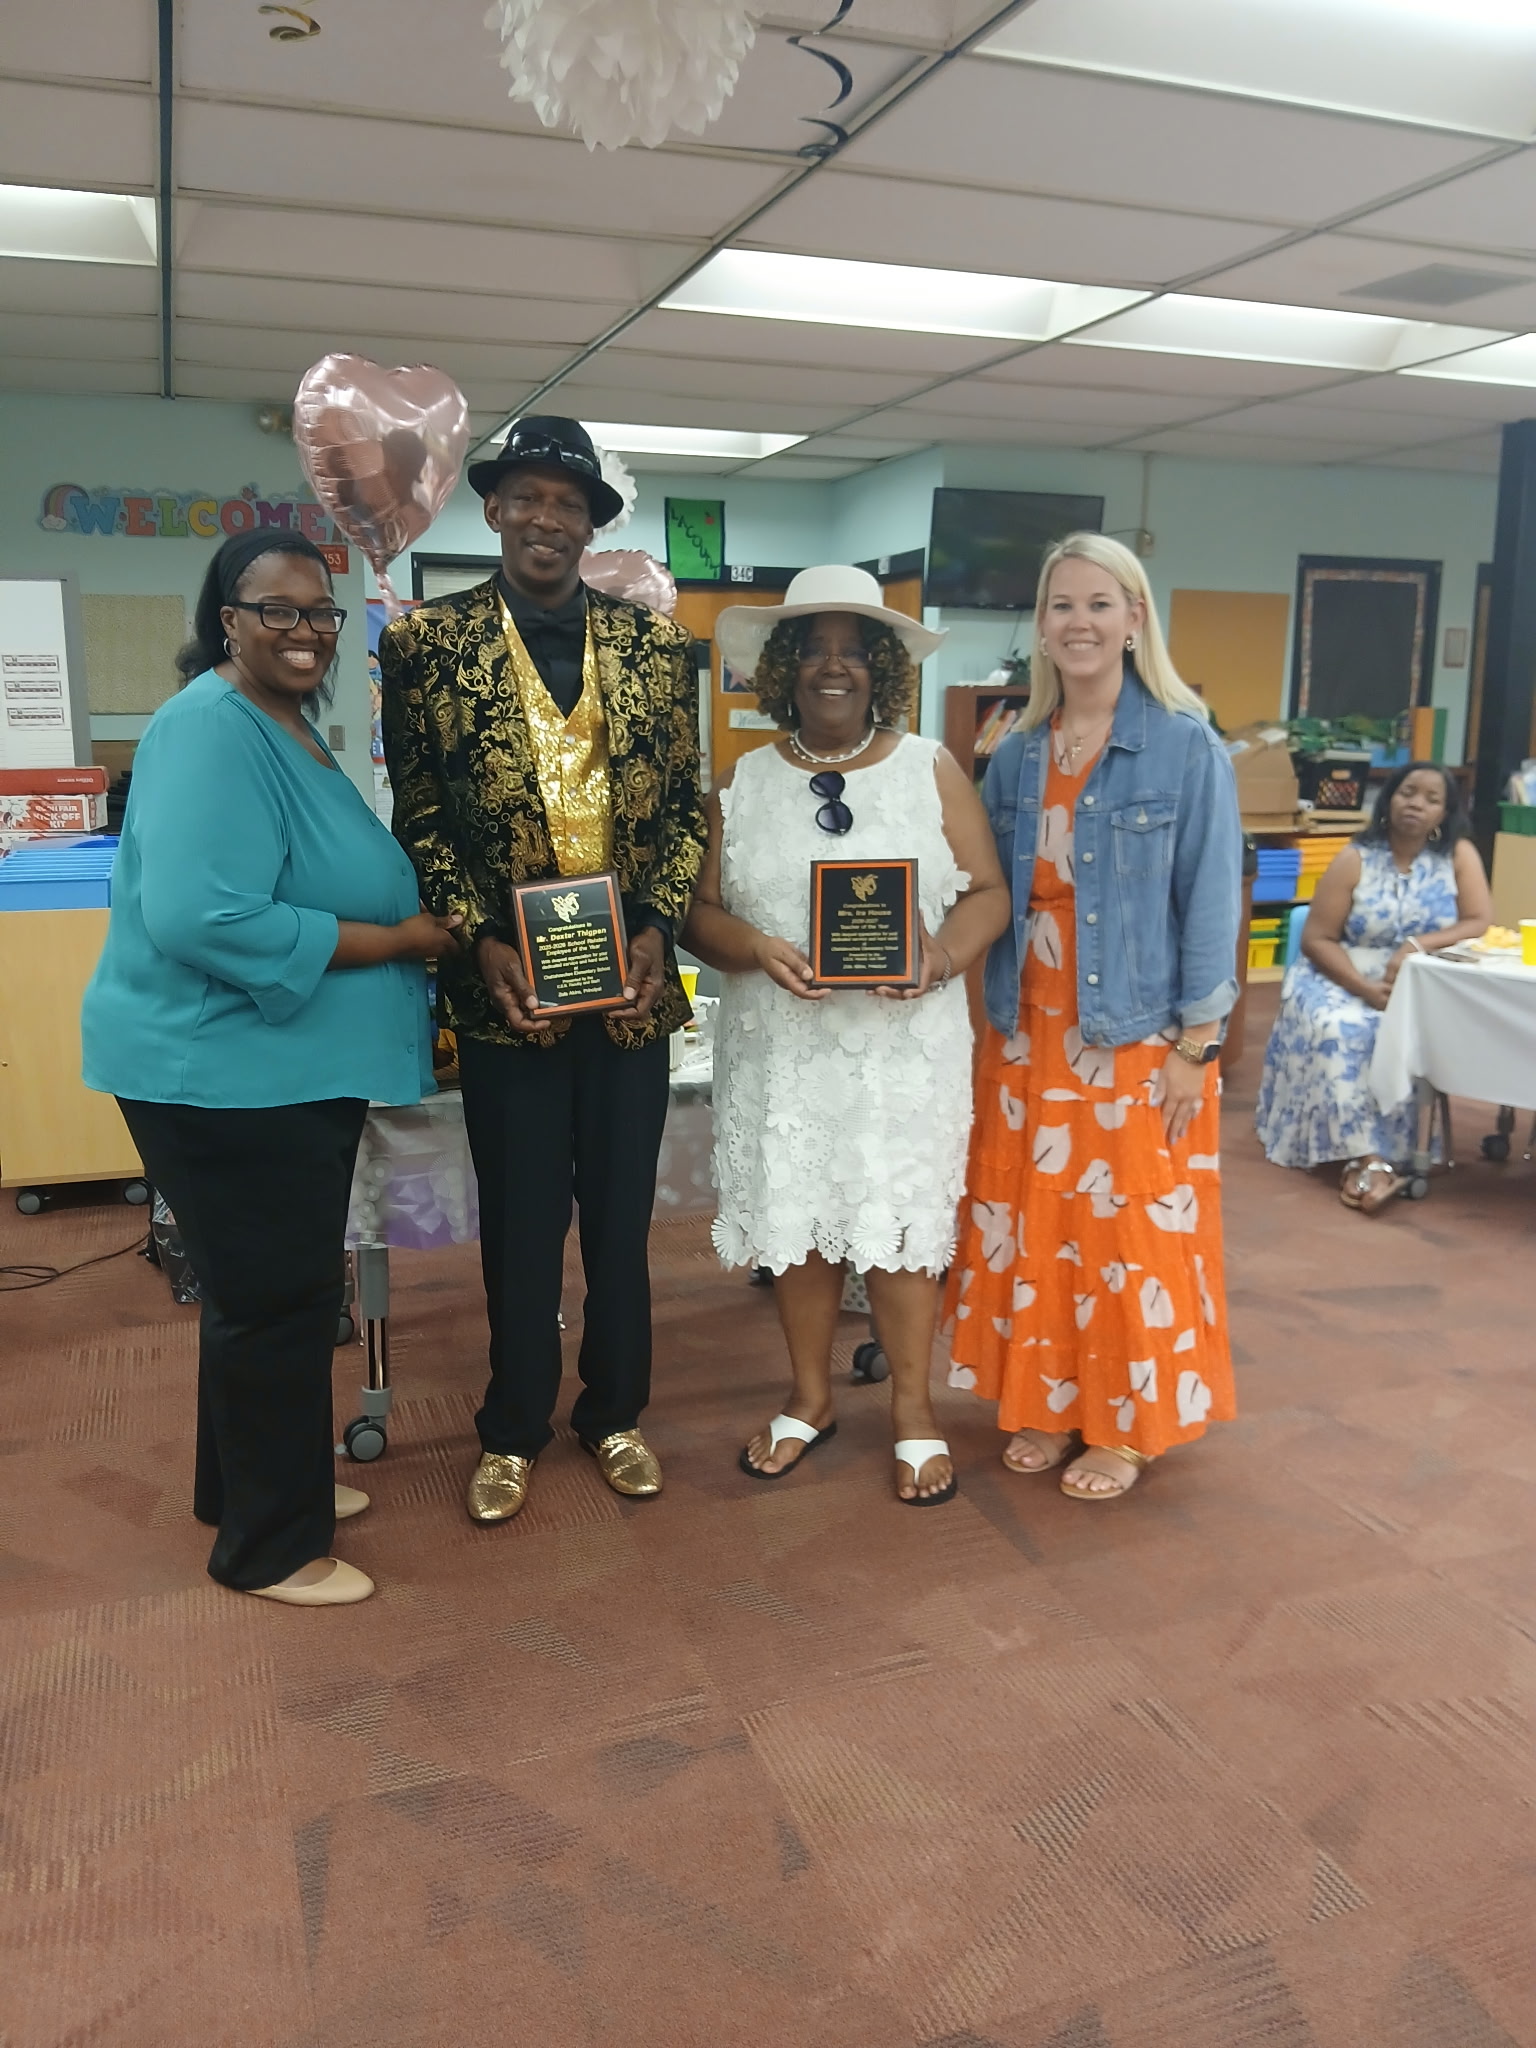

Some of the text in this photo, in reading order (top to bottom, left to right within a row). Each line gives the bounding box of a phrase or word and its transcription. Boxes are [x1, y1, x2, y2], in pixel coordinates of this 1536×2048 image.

[70, 496, 326, 541] WELCOME
[50, 820, 66, 828] KIT
[551, 932, 575, 941] Dexter
[577, 928, 607, 937] Thigpen
